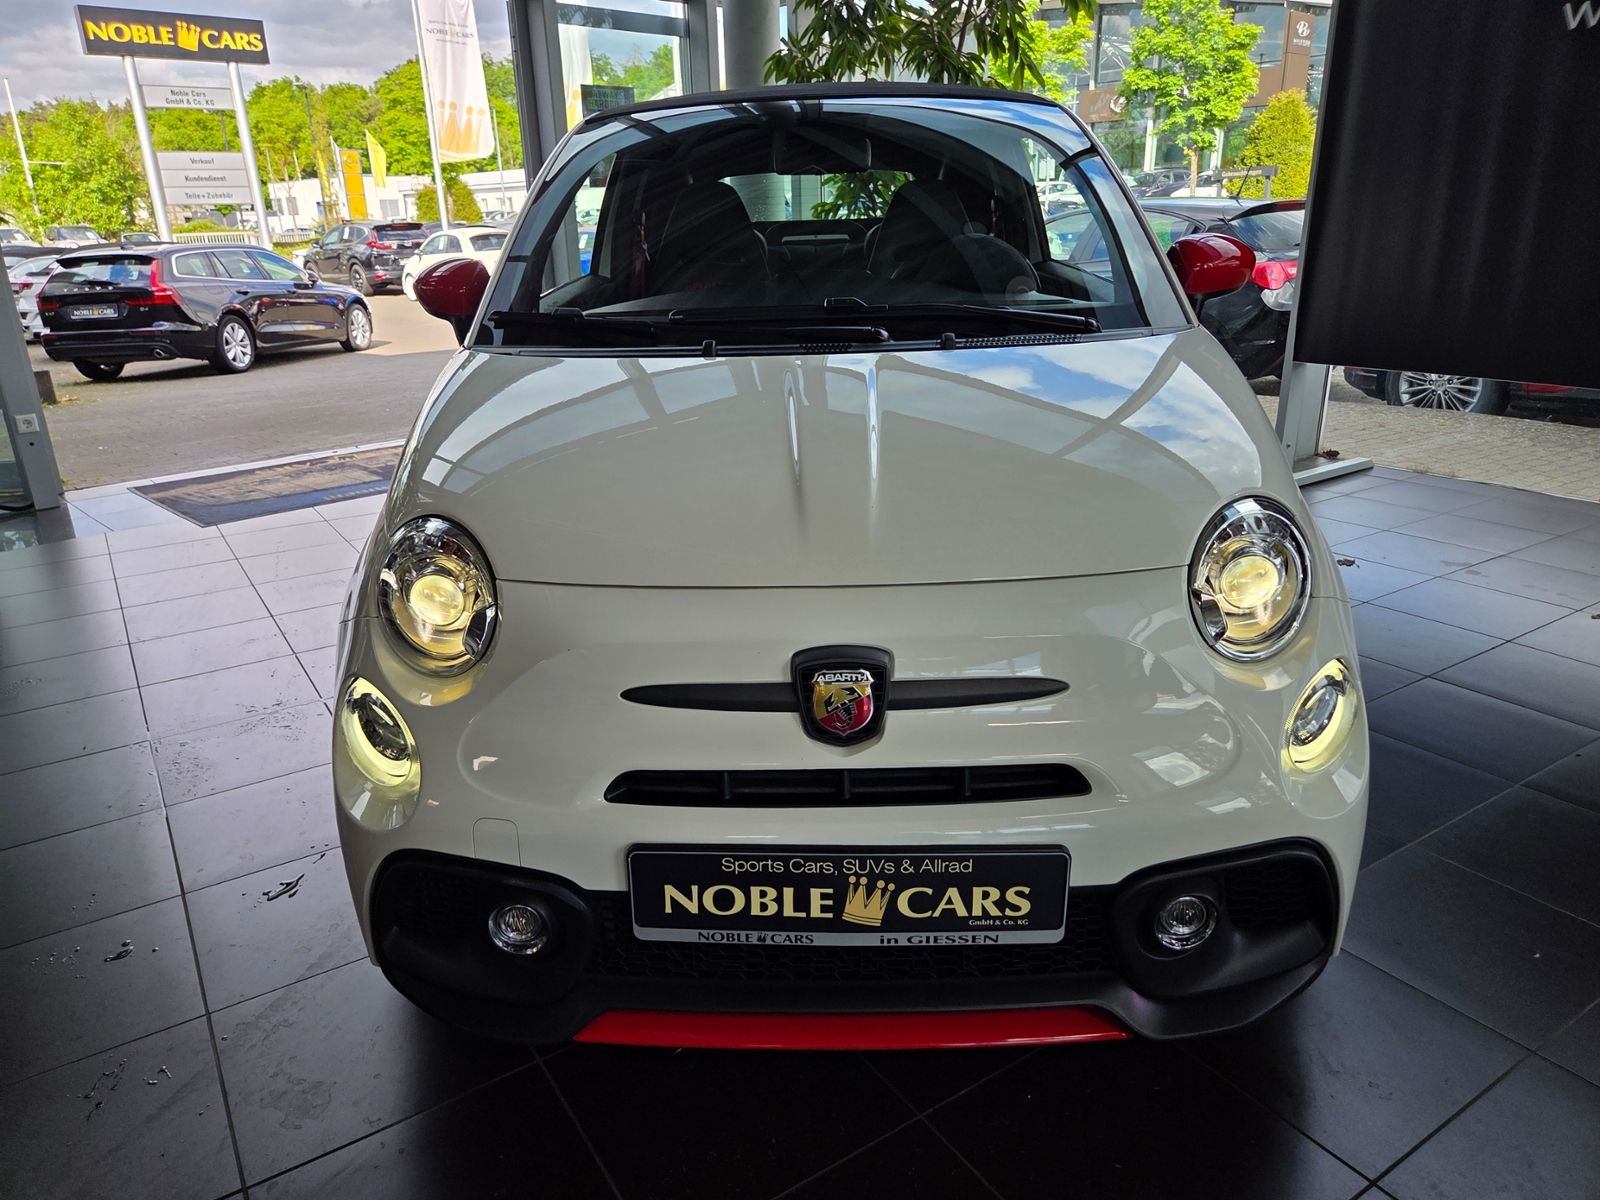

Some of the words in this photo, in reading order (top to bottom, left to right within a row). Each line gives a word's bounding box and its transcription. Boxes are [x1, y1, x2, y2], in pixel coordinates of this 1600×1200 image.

[84, 20, 175, 46] NOBLE
[201, 30, 264, 52] CARS
[170, 89, 190, 97] Noble
[191, 90, 206, 98] Cars
[816, 673, 867, 682] ABARTH
[721, 857, 785, 875] Sports
[789, 858, 838, 876] Cars,
[842, 858, 896, 875] SUVs
[900, 858, 915, 874] &
[919, 858, 973, 874] Allrad
[663, 884, 835, 919] NOBLE
[896, 885, 1032, 919] CARS
[698, 931, 753, 943] NOBLE
[770, 933, 814, 945] CARS
[879, 935, 899, 945] in
[906, 934, 1000, 945] GIESSEN
